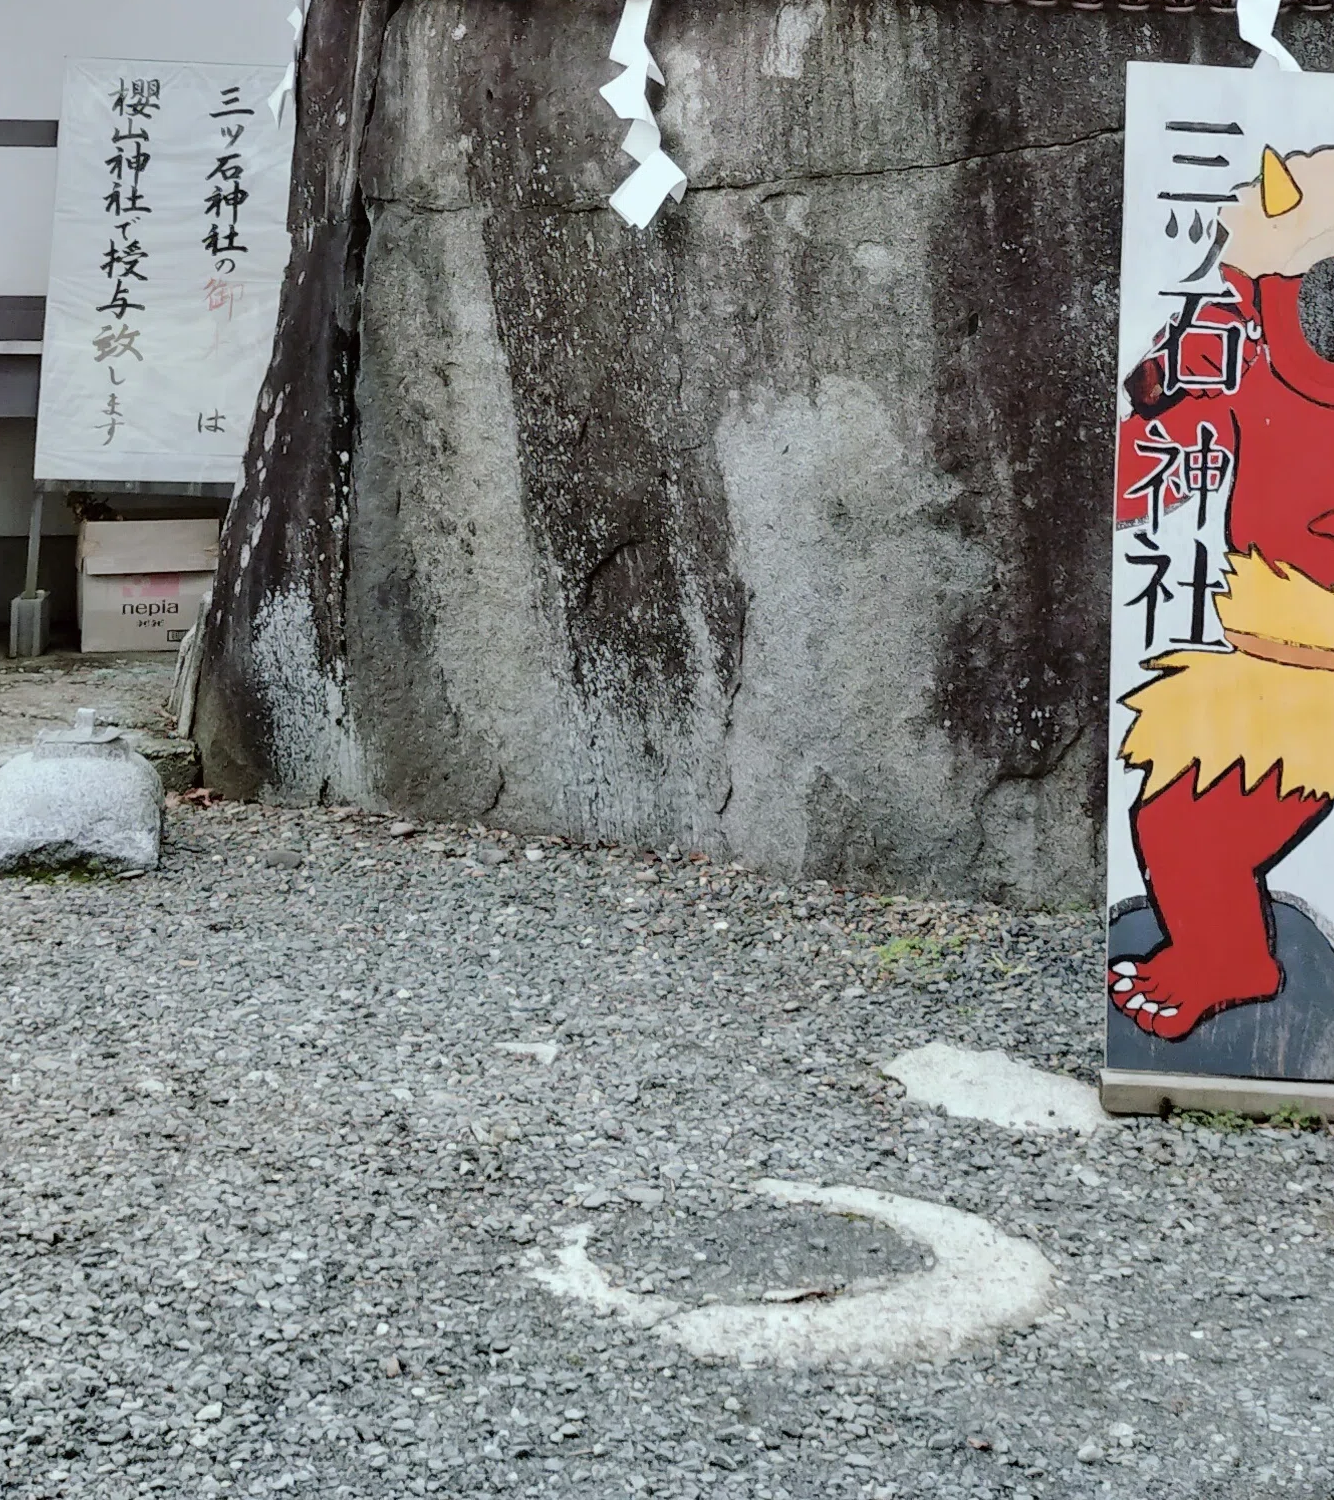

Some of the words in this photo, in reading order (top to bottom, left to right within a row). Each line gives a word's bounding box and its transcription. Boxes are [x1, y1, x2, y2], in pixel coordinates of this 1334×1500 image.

[92, 77, 162, 447] 櫻山神社で授与致します
[1125, 119, 1245, 651] 三ツ石神社
[121, 599, 179, 616] nepia
